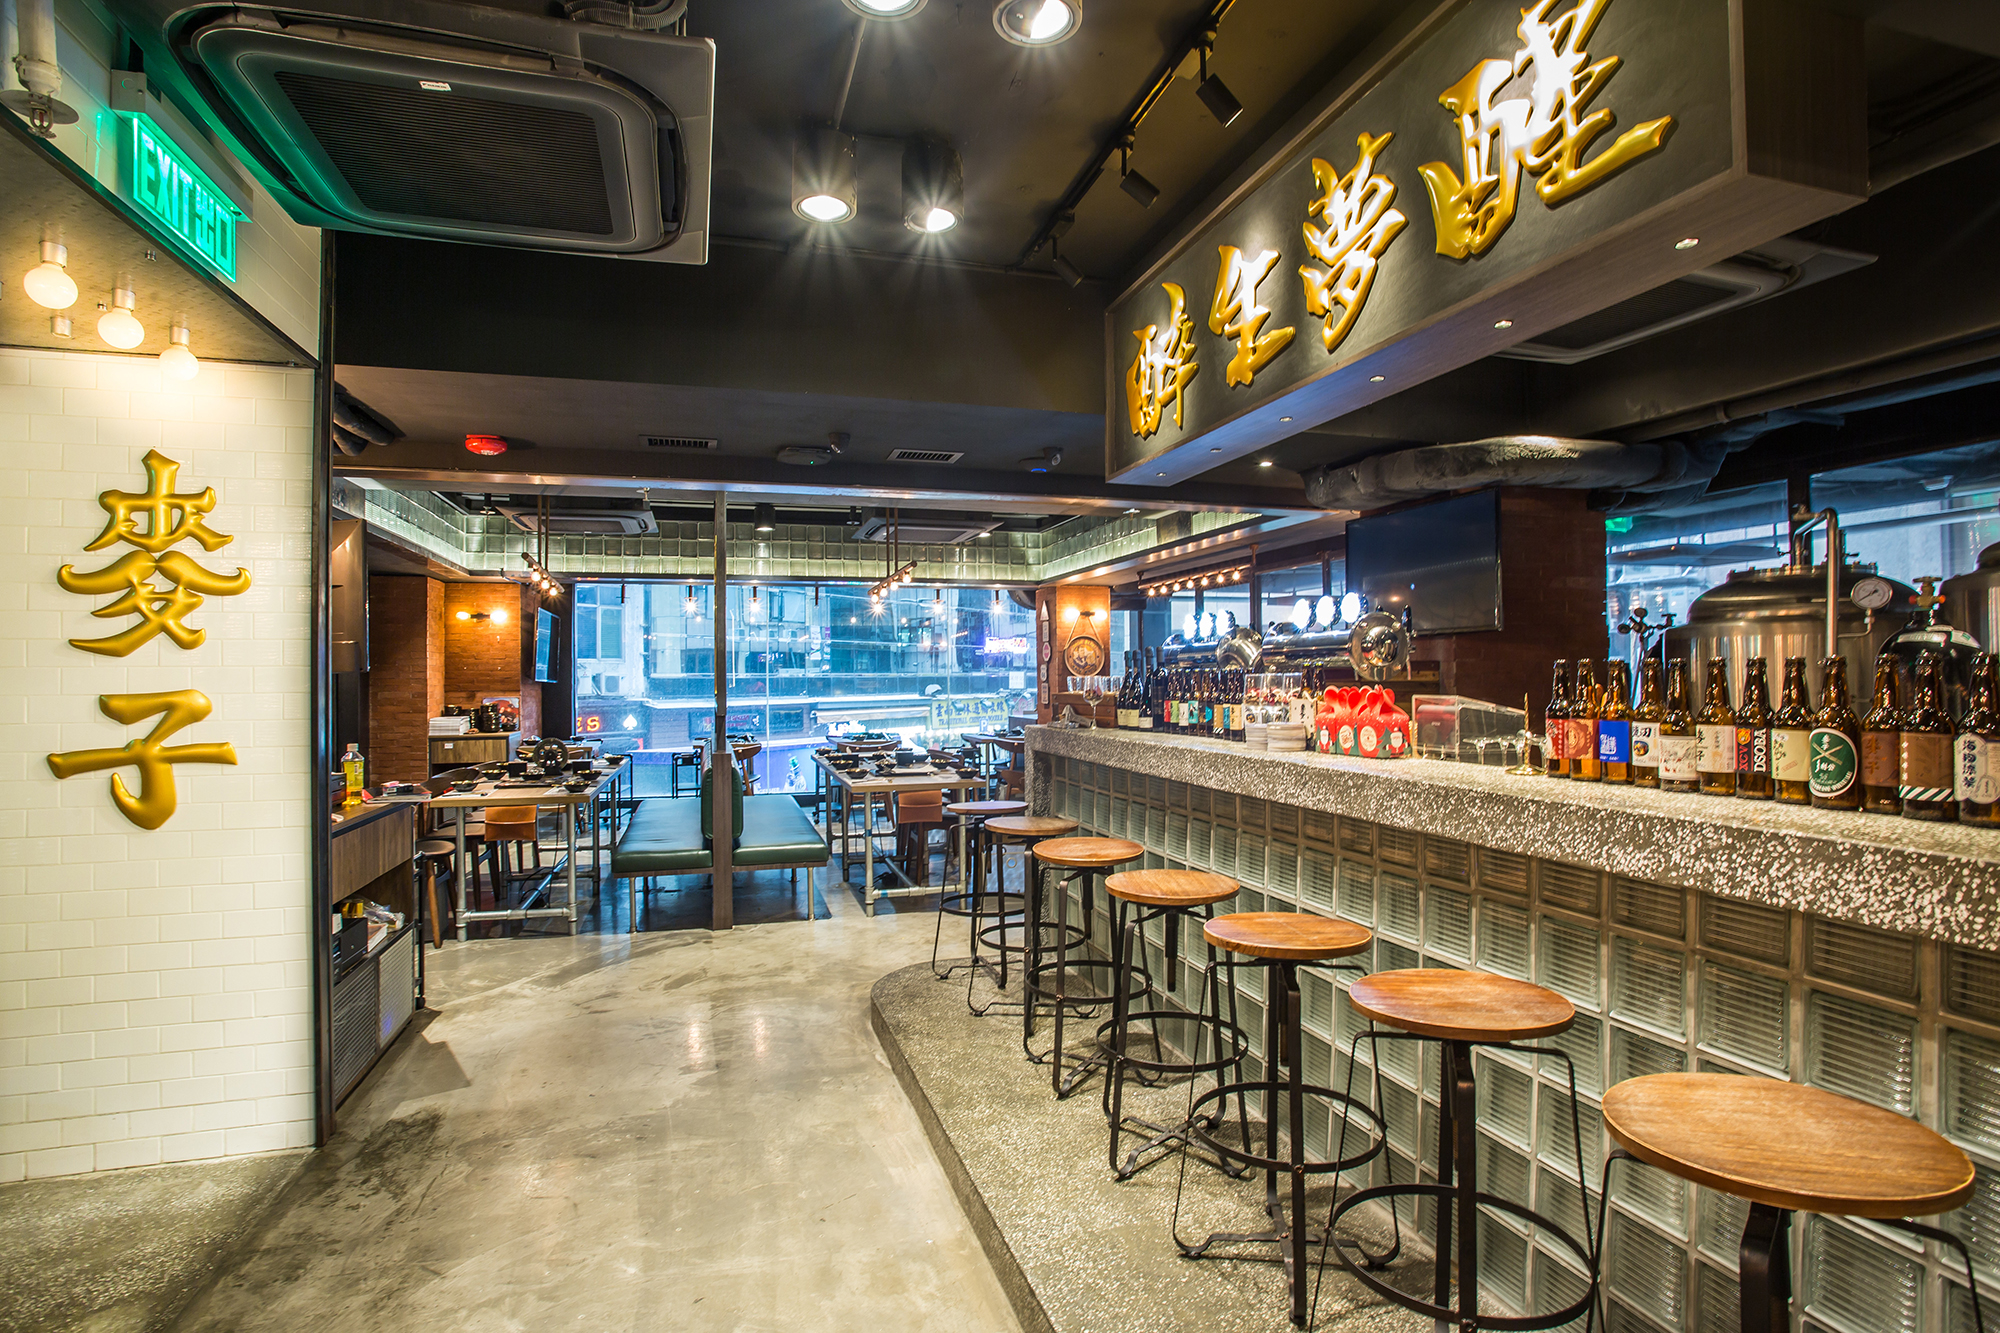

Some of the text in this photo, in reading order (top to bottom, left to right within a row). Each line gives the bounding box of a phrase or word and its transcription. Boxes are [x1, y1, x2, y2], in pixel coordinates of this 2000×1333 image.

[141, 131, 192, 237] EXIT
[195, 183, 233, 275] 出口
[47, 449, 252, 830] 麥子
